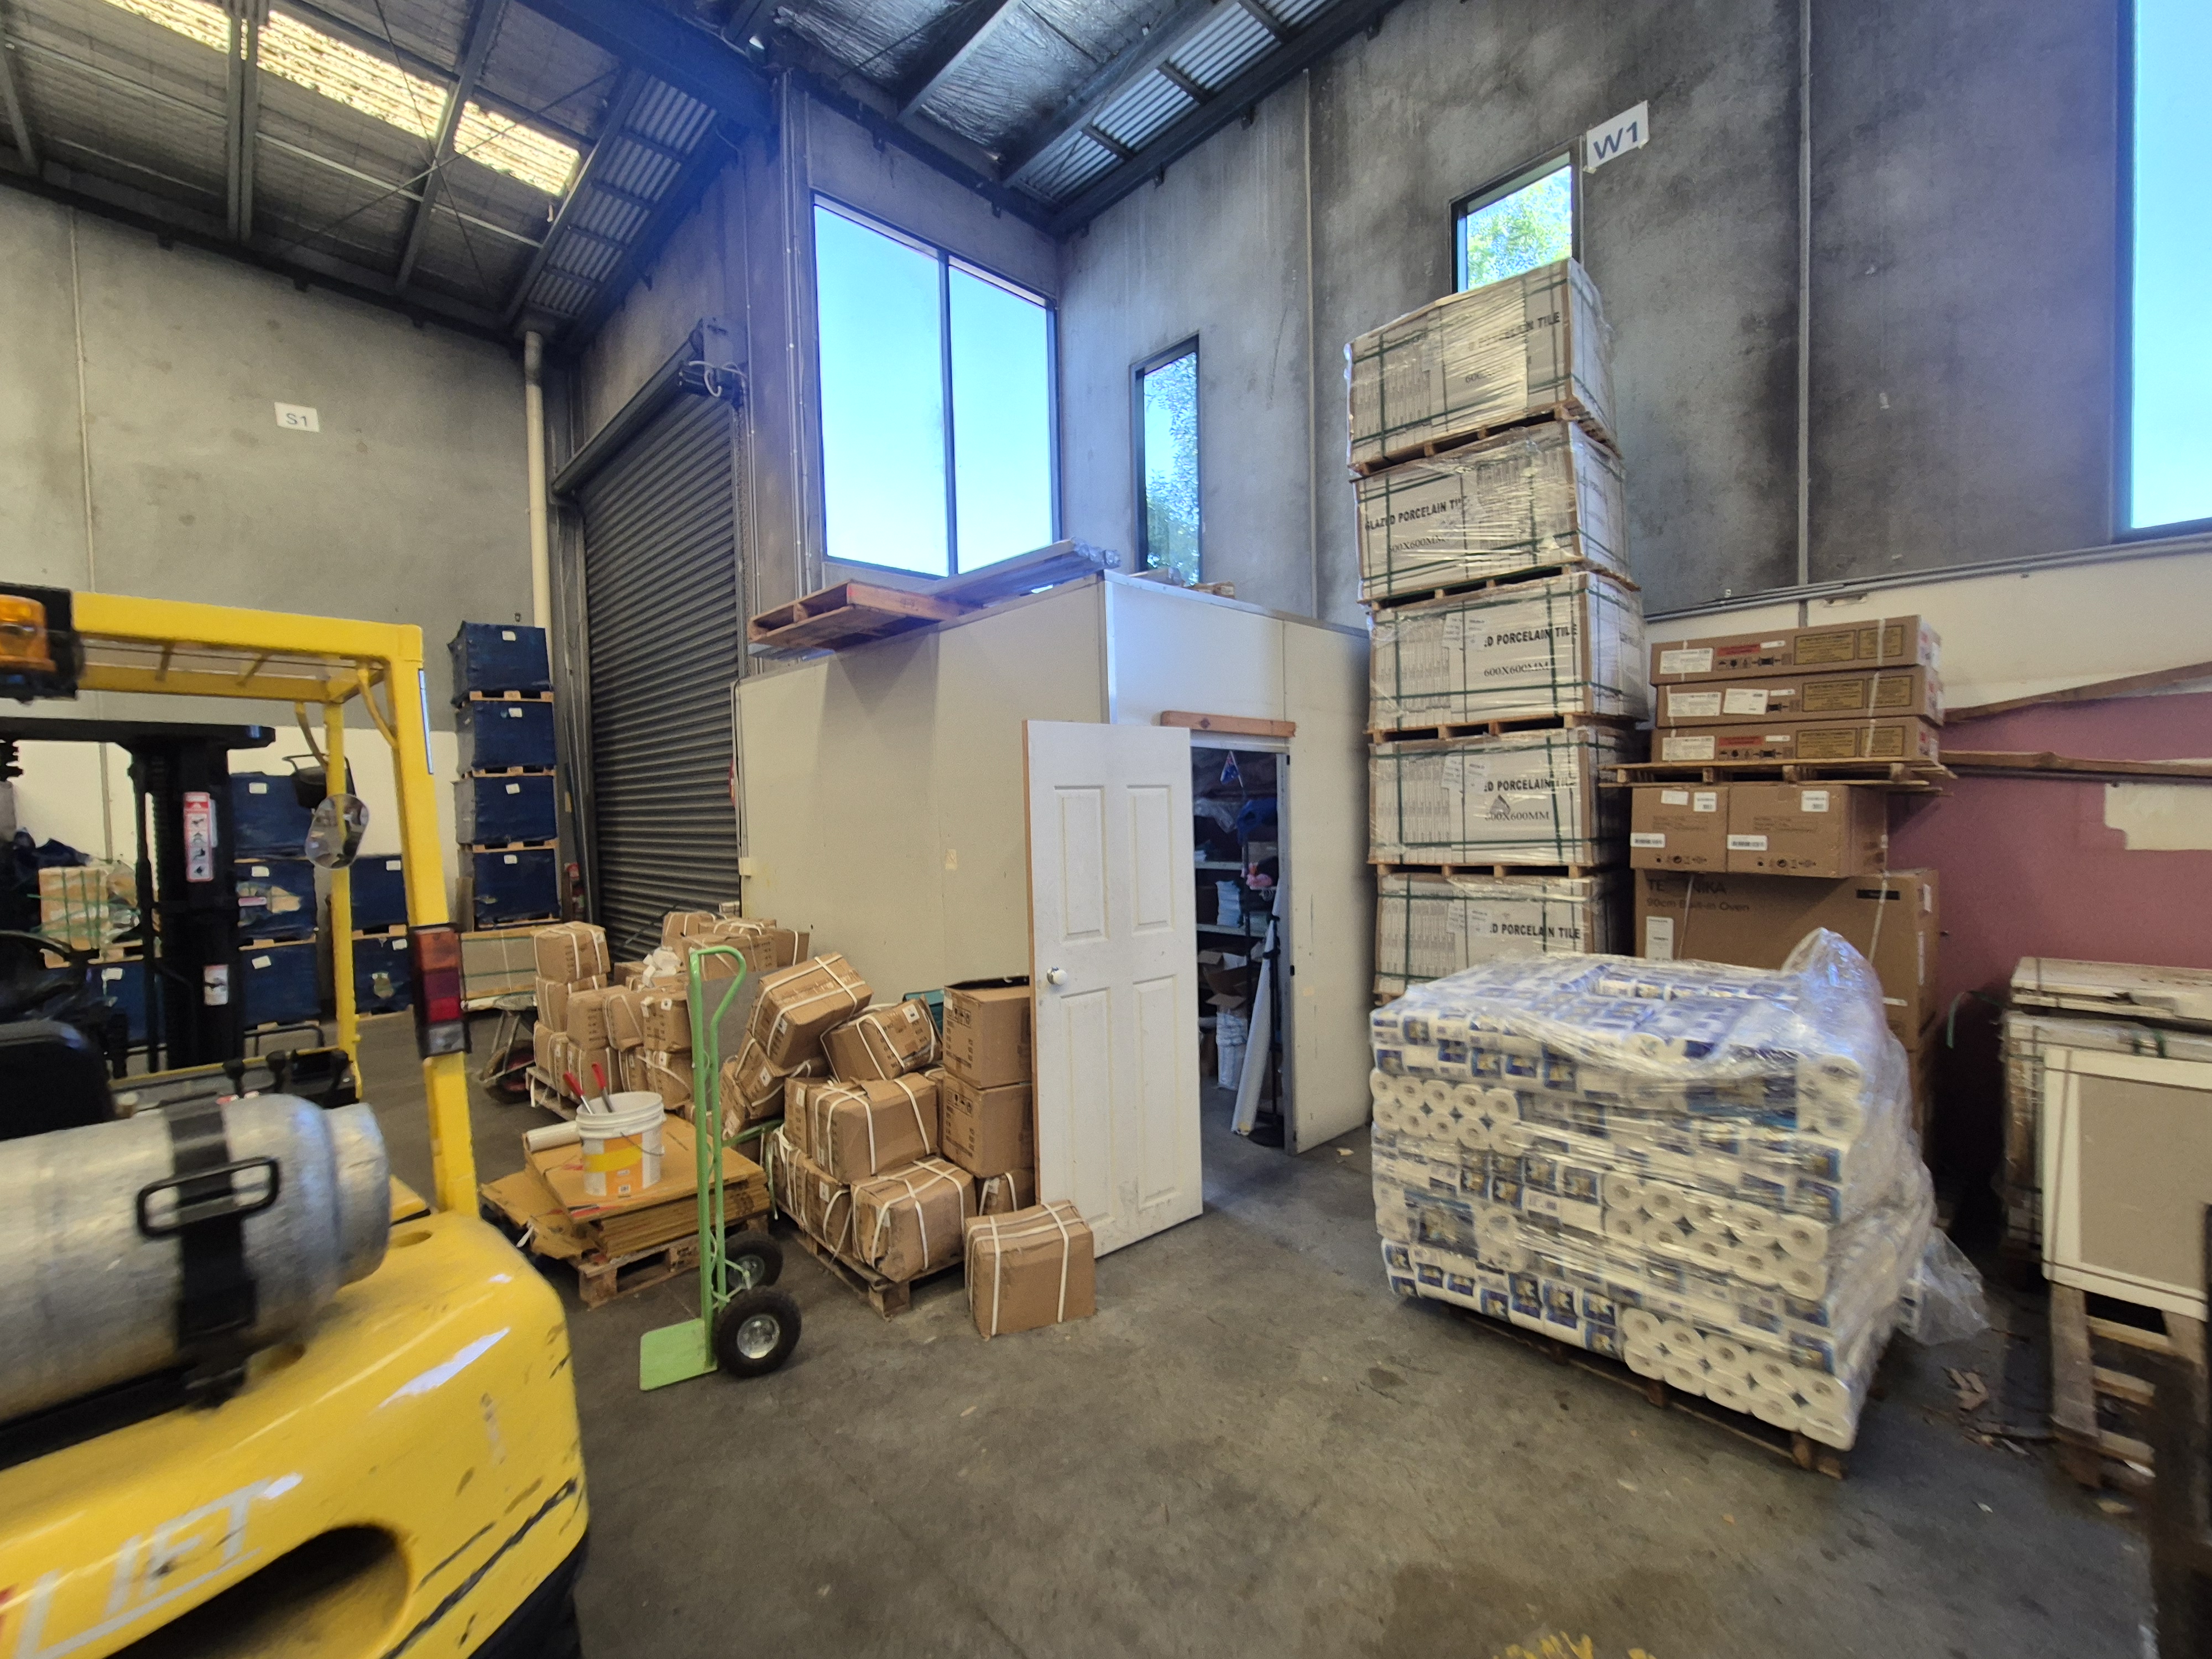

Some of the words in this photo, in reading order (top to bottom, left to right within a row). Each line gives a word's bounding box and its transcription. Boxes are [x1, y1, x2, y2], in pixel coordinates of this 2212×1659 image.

[1593, 121, 1637, 160] W1
[286, 413, 307, 427] S1
[1398, 502, 1447, 523] PORCELAIN
[1496, 628, 1552, 645] PORCELAIN
[1498, 779, 1552, 792] PORCELAIN
[1502, 924, 1554, 937] PORCELAN
[1558, 927, 1580, 939] TILE
